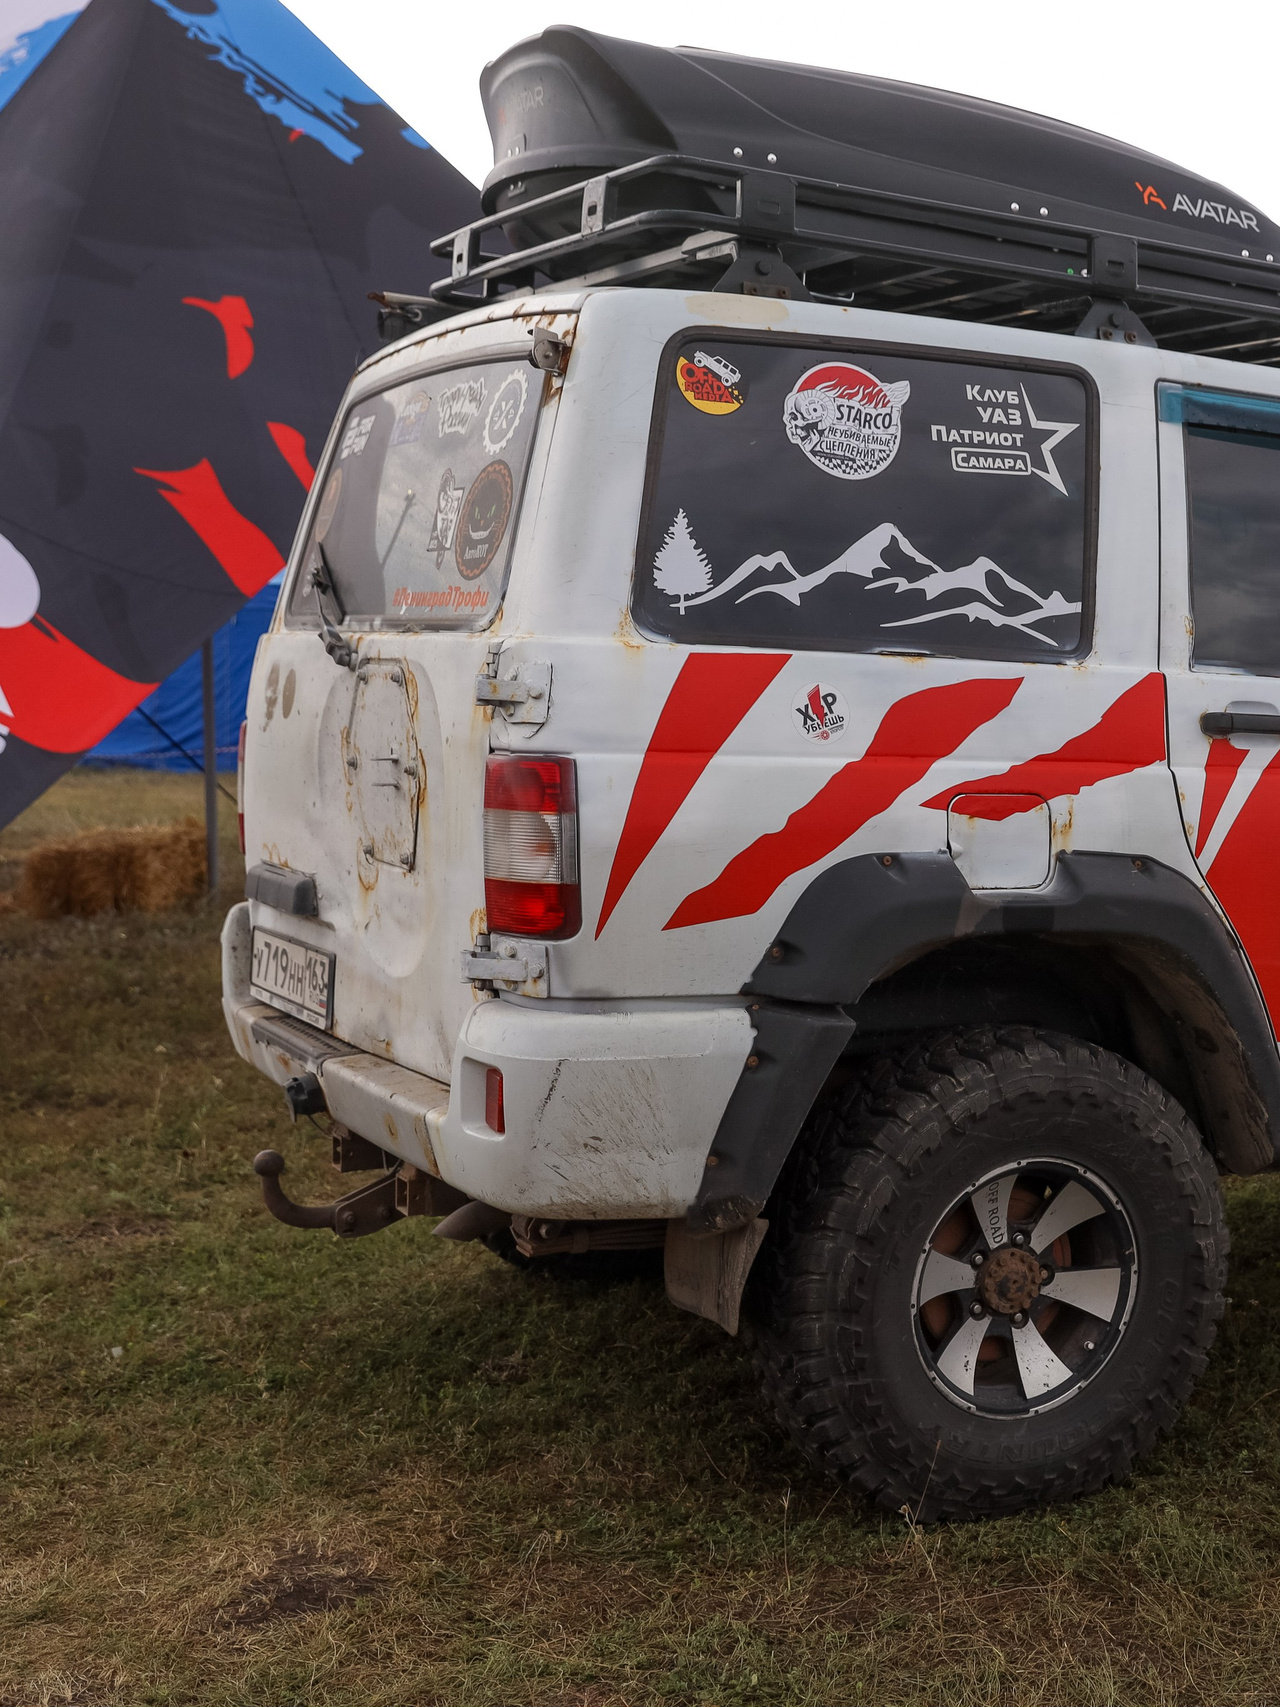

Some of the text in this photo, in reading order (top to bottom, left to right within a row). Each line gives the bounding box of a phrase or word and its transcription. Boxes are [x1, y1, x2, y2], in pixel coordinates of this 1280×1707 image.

[1172, 193, 1260, 233] AVATAR
[681, 363, 717, 384] OFF
[685, 381, 725, 395] ROAD
[694, 389, 735, 404] MEDIA
[836, 403, 892, 429] STARCO
[976, 406, 1022, 426] УАЗ
[828, 427, 892, 447] НЕУБИВАЕМЫЕ
[820, 440, 876, 460] СЦЕПЛЕНИЯ
[795, 692, 838, 727] ХР
[987, 1181, 1004, 1244] OFF ROAD
